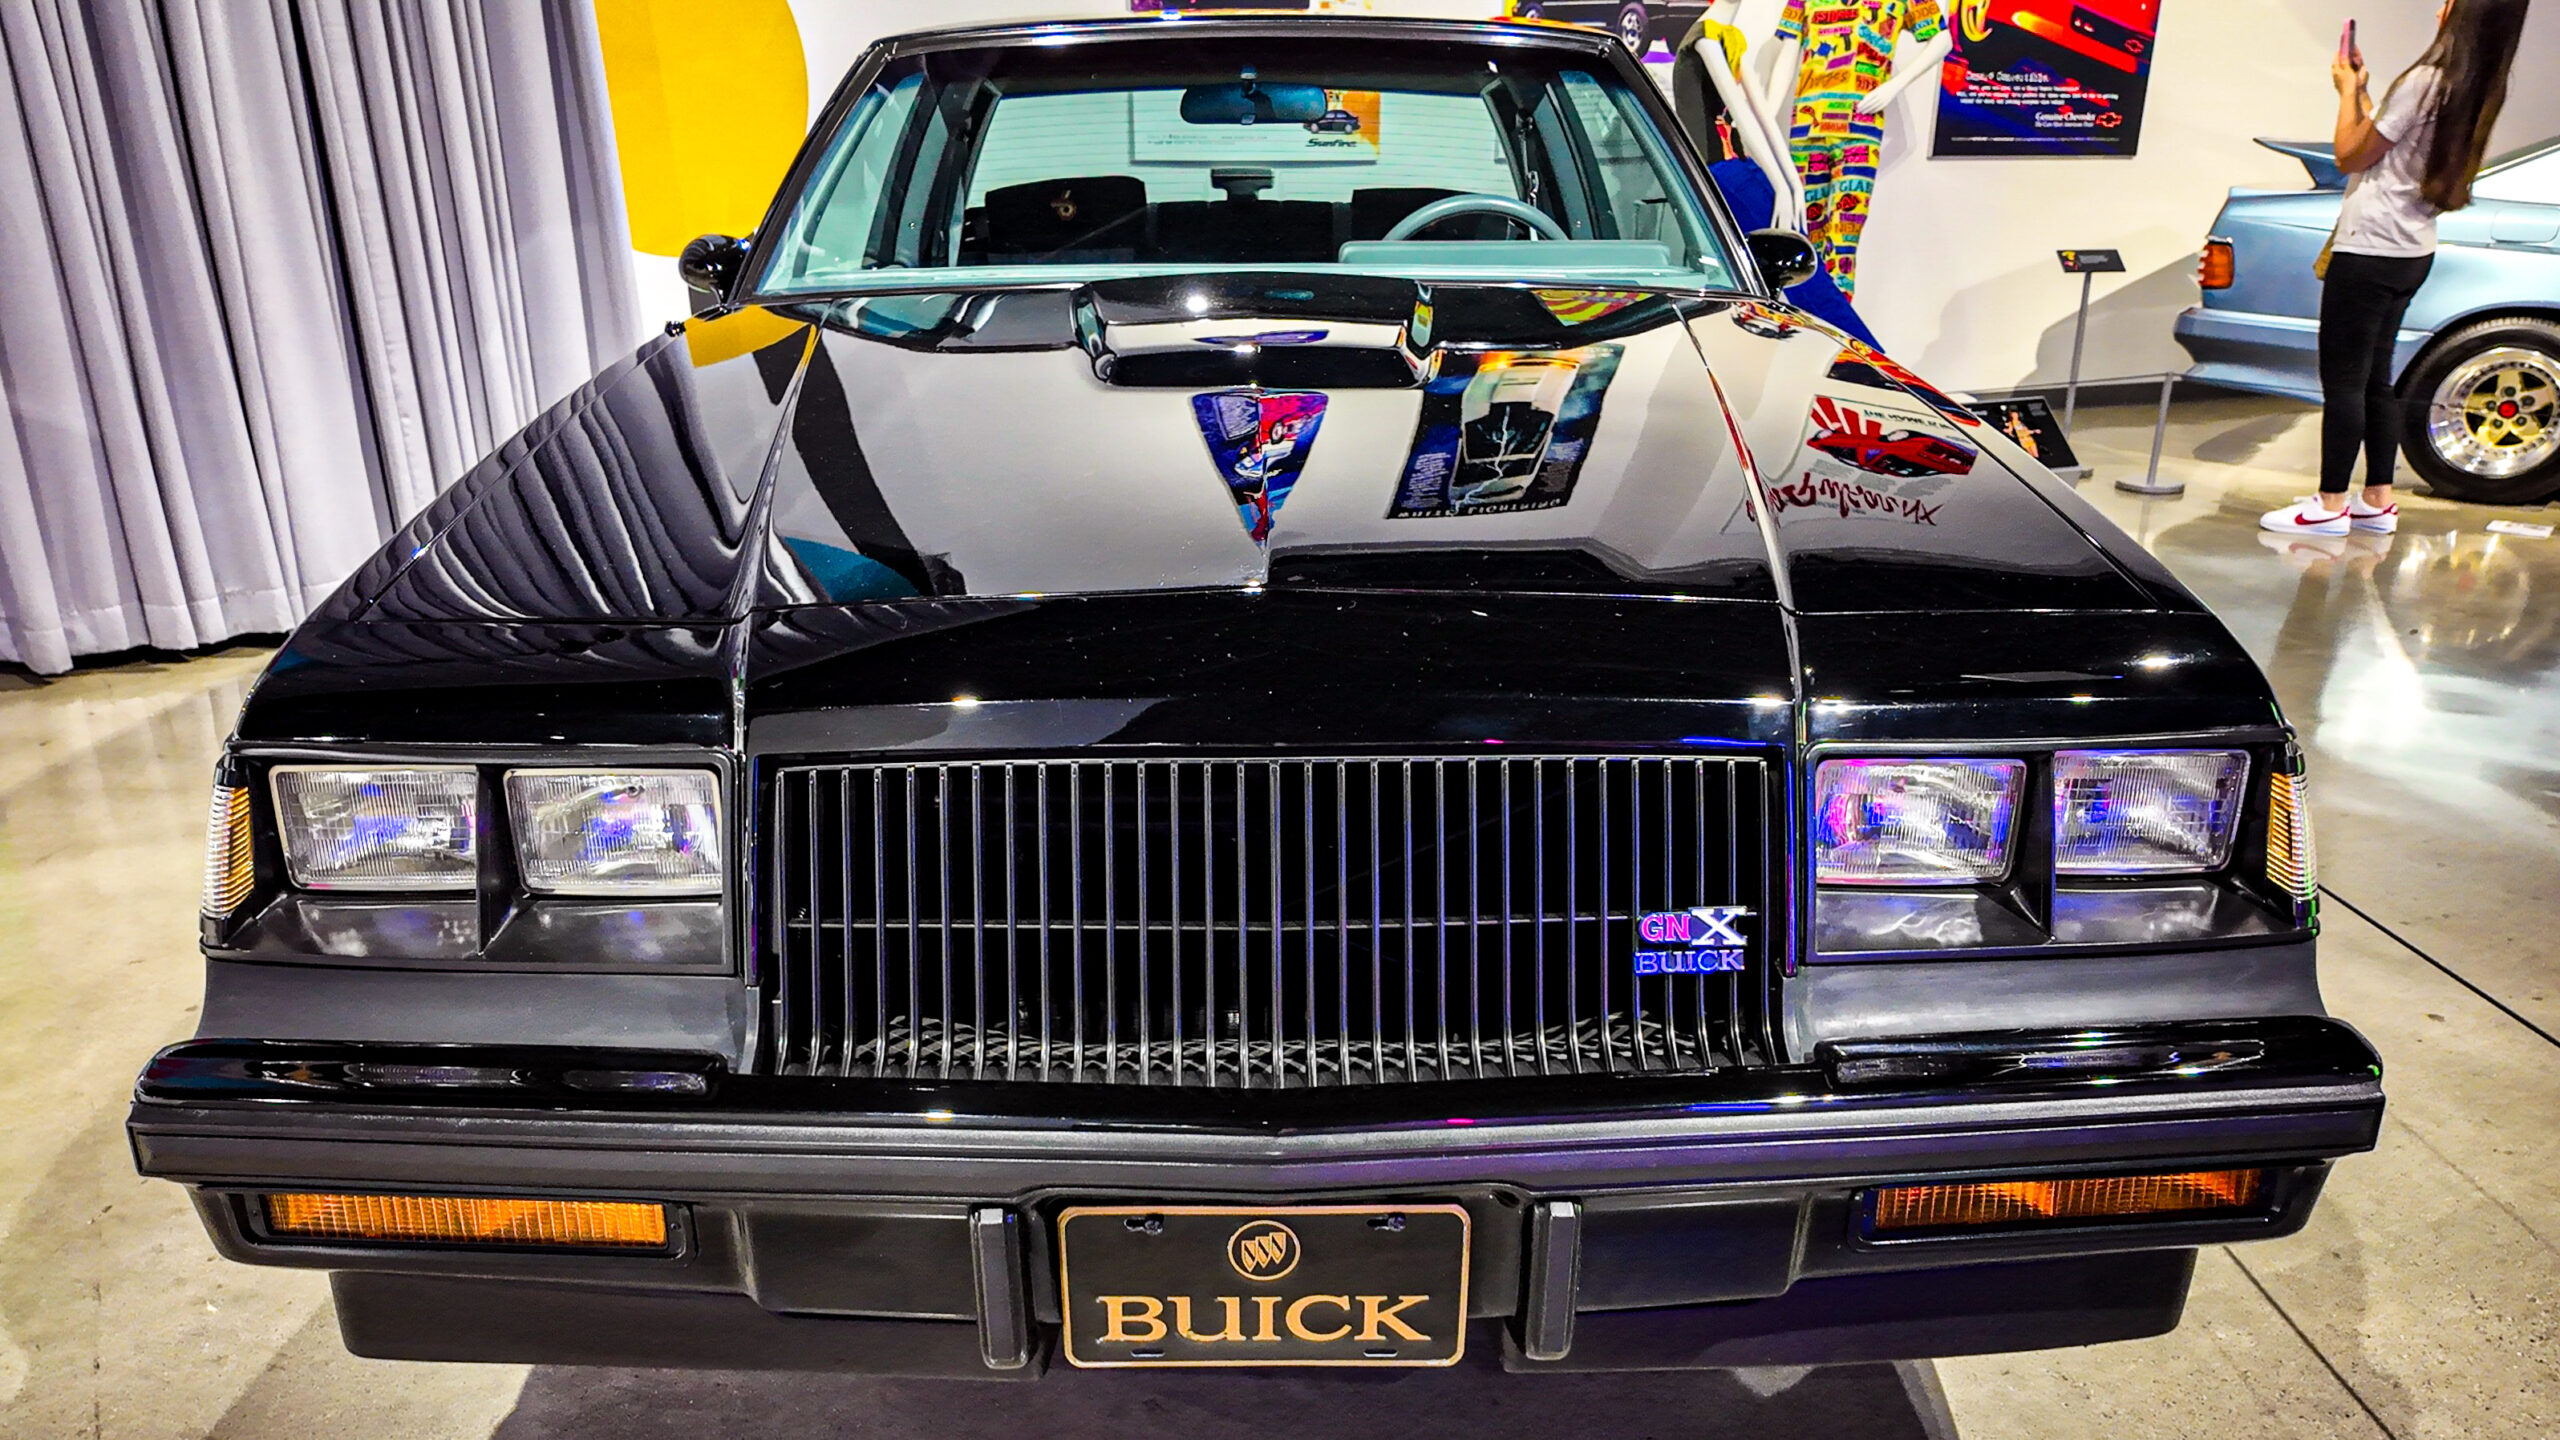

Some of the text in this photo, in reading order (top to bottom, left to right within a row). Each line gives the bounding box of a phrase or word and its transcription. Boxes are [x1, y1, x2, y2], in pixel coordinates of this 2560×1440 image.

[1305, 138, 1357, 148] Sunfire
[1640, 906, 1748, 946] GNX
[1634, 949, 1746, 975] BUICK
[1096, 1294, 1432, 1343] BUICK
